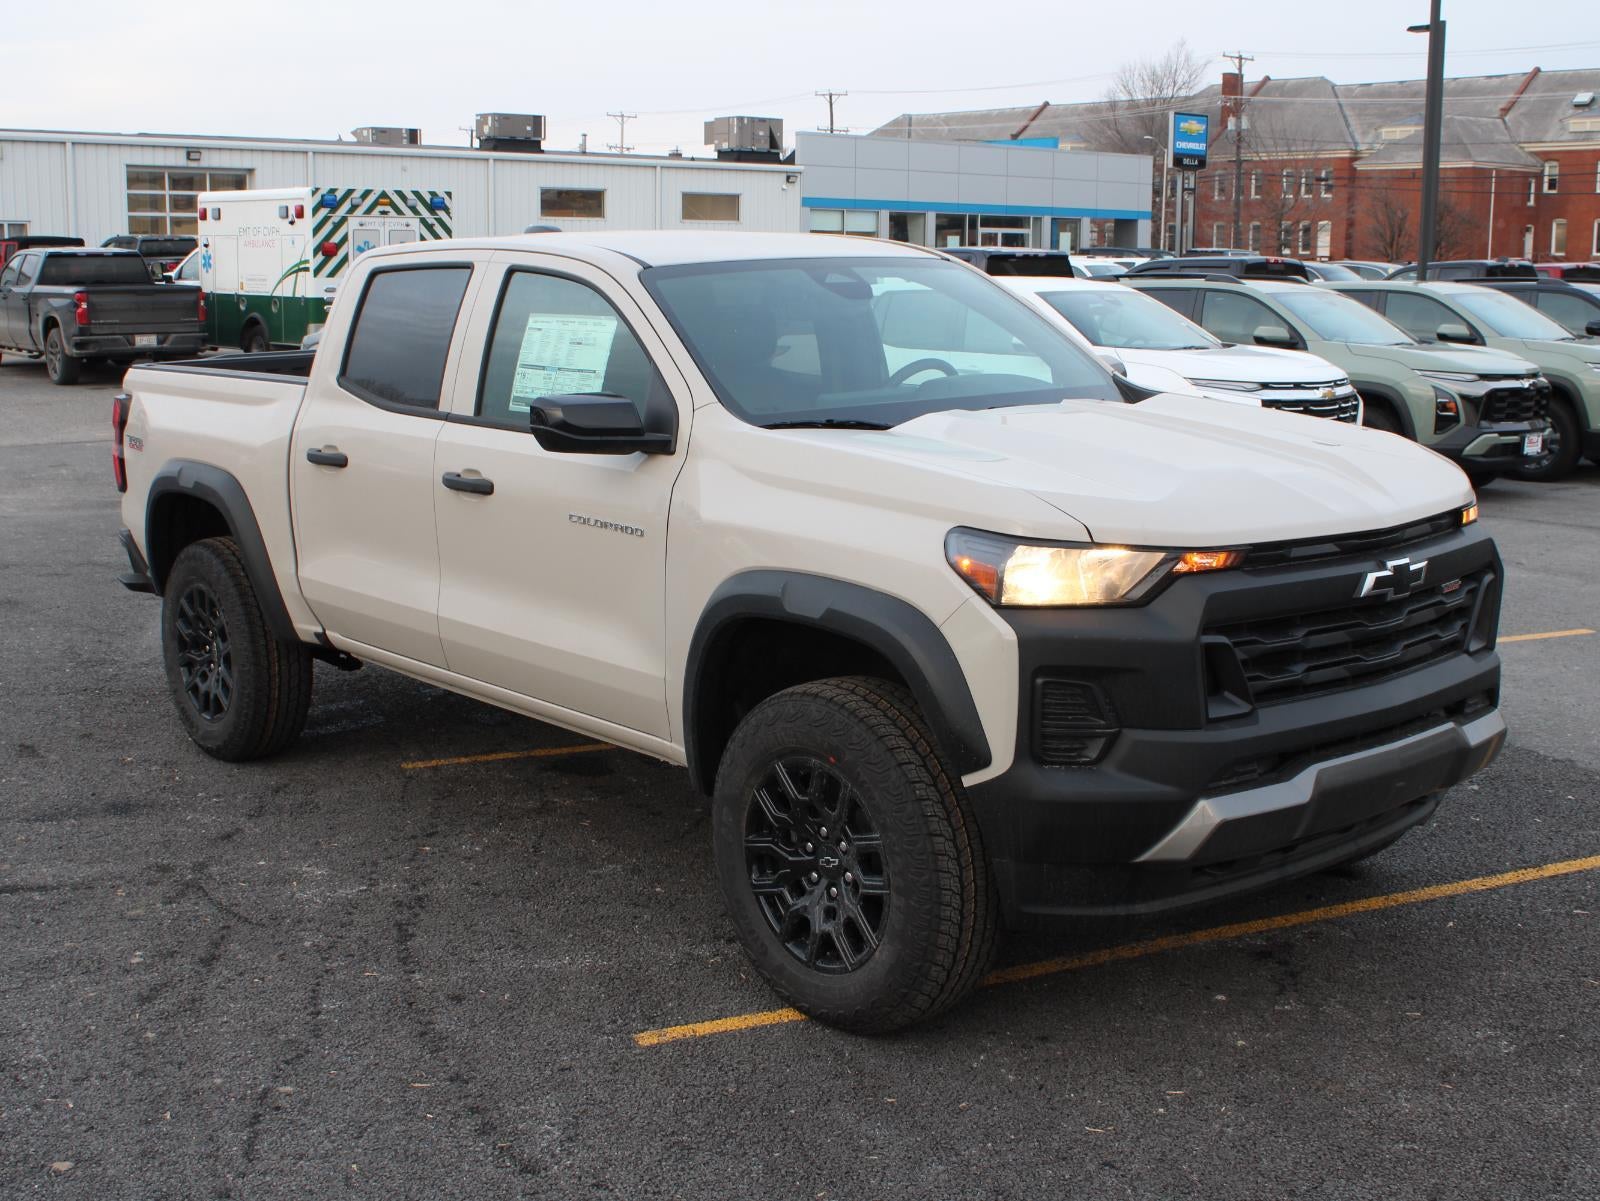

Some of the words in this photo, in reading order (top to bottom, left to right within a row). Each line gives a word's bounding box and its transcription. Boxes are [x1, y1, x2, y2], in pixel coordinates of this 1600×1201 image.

[1176, 141, 1206, 150] CHEVROLET
[238, 226, 251, 236] EMT
[253, 226, 262, 236] OF
[243, 239, 276, 248] AMBULANCE
[568, 513, 645, 537] COLORADO
